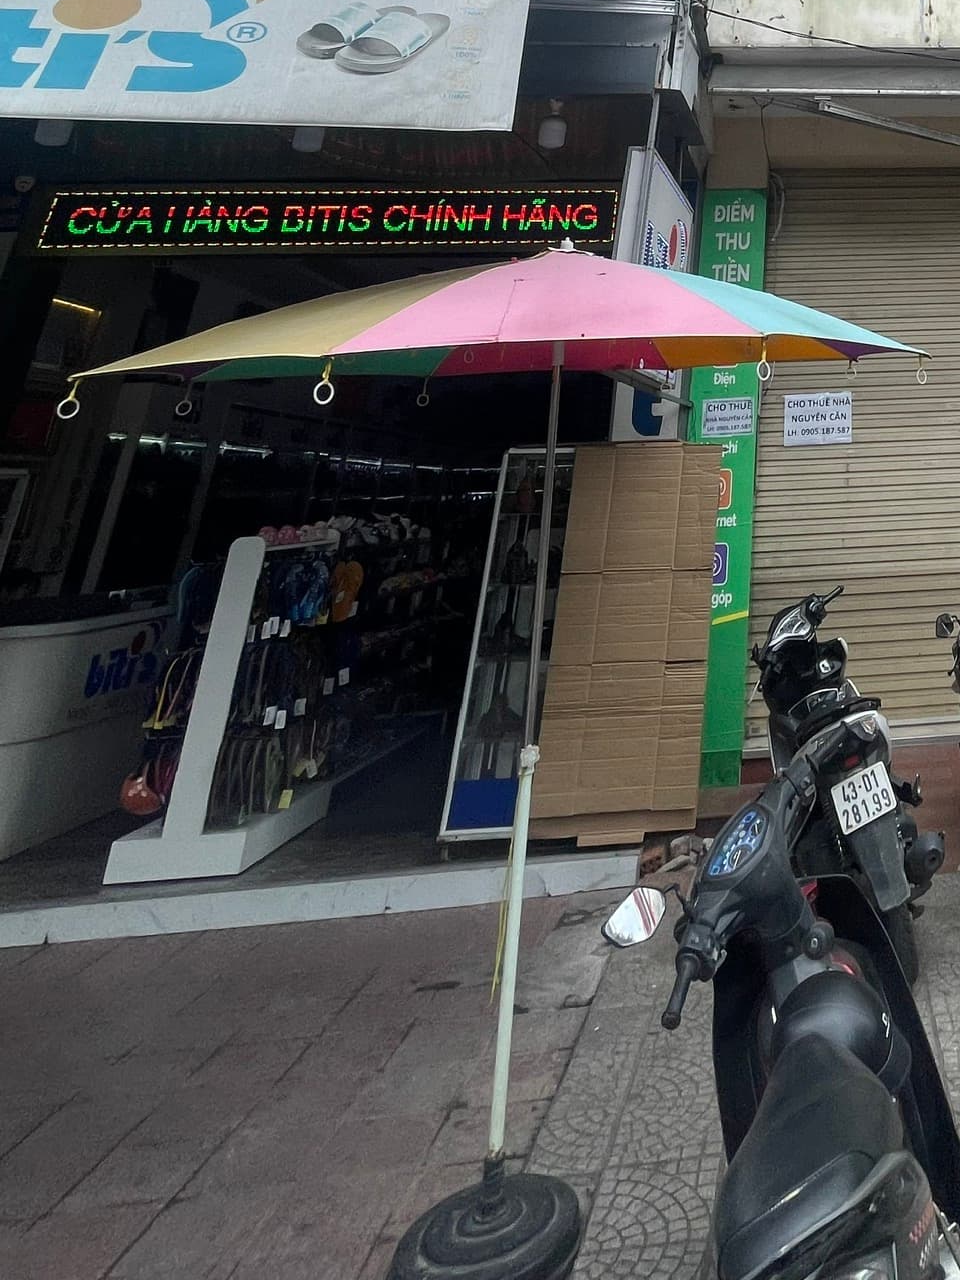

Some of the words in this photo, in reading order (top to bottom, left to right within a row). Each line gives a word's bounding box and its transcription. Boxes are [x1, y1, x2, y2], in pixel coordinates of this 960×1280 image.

[280, 205, 372, 232] BITIS
[383, 199, 491, 233] CHÍNH
[502, 199, 598, 232] HÃNG
[714, 197, 755, 223] ĐIỂM
[715, 232, 751, 251] THU
[712, 256, 751, 282] TIỀN
[713, 371, 736, 388] Điện
[708, 404, 726, 412] CHO
[787, 400, 805, 408] CHO
[833, 397, 851, 406] NHÀ
[842, 769, 879, 803] 43-D1
[842, 788, 891, 830] 281.99
